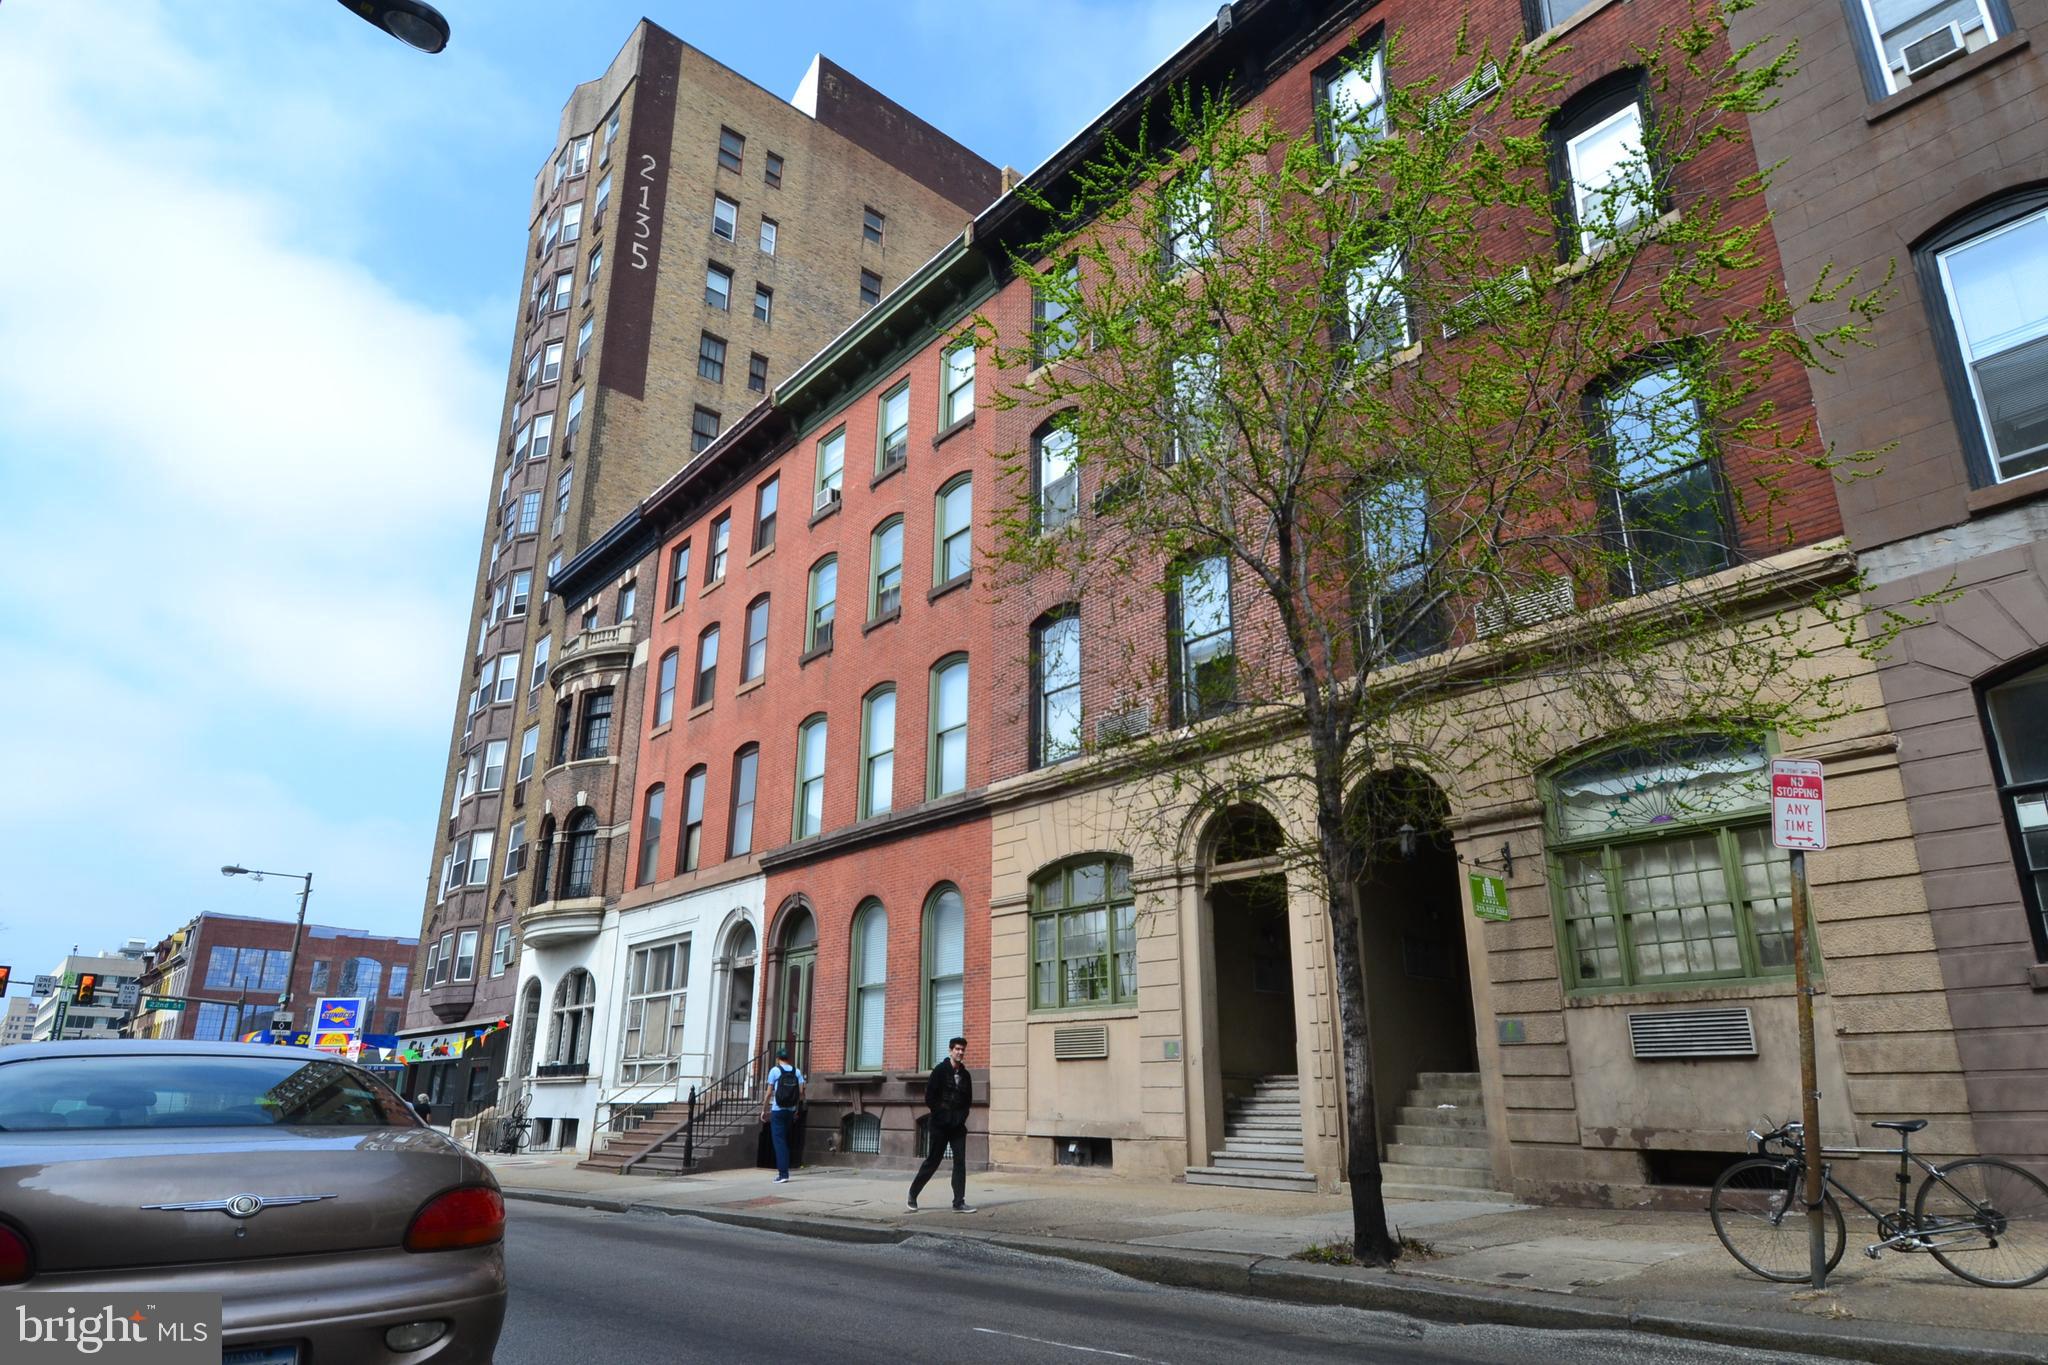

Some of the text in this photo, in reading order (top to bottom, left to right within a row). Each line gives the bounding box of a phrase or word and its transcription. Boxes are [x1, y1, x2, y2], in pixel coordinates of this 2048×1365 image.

[631, 154, 657, 270] 2135
[1790, 776, 1804, 787] NO
[1776, 786, 1819, 799] STOPPING
[1786, 803, 1810, 816] ANY
[1784, 819, 1814, 833] TIME
[322, 1010, 355, 1020] SUNOCO
